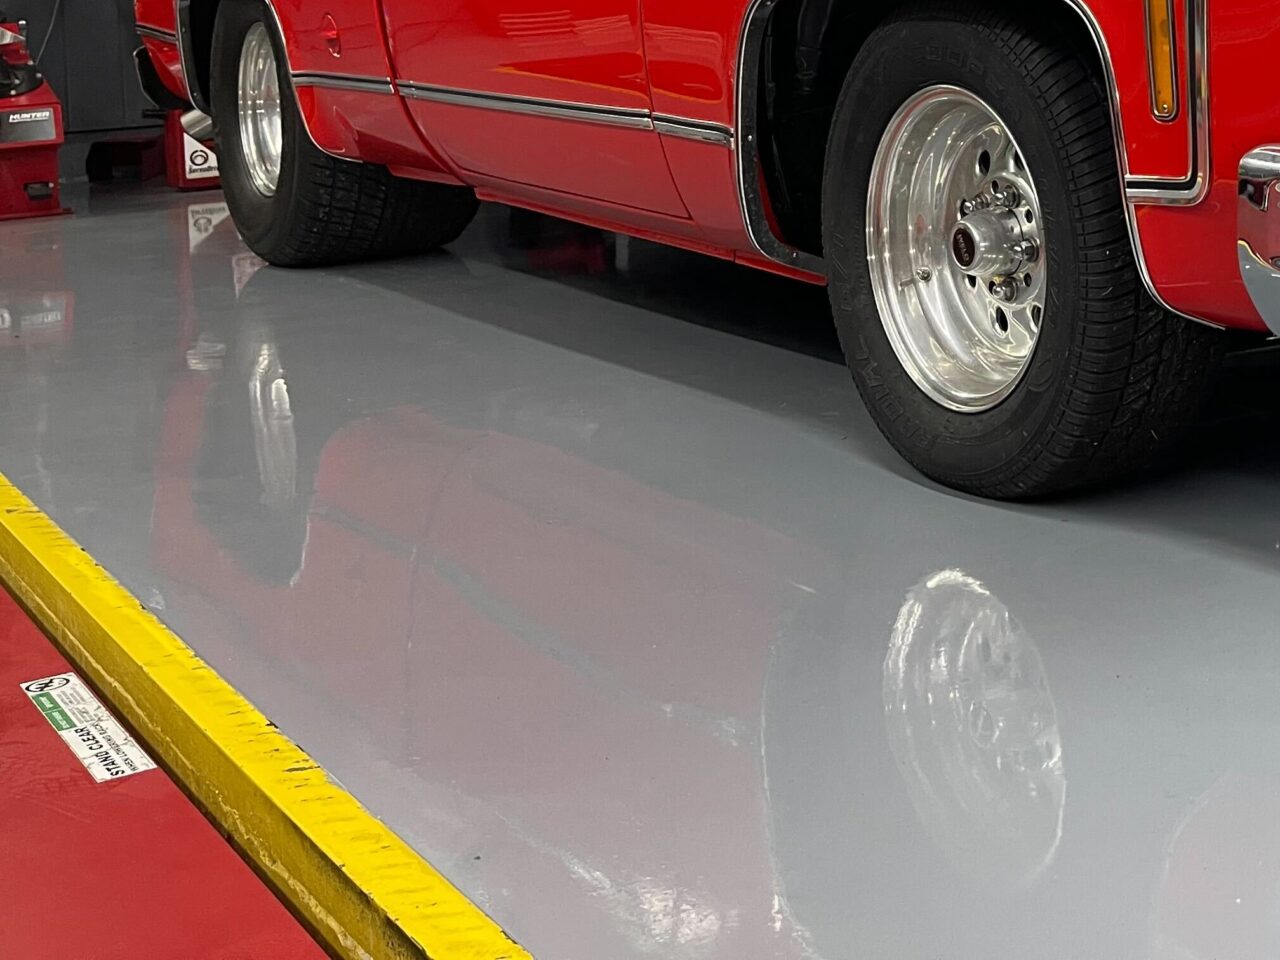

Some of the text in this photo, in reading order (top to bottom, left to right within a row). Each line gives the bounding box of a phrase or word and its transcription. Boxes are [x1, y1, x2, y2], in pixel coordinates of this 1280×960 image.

[9, 111, 50, 123] HUNTER
[73, 726, 103, 750] CLEAR
[93, 750, 125, 776] STAND
